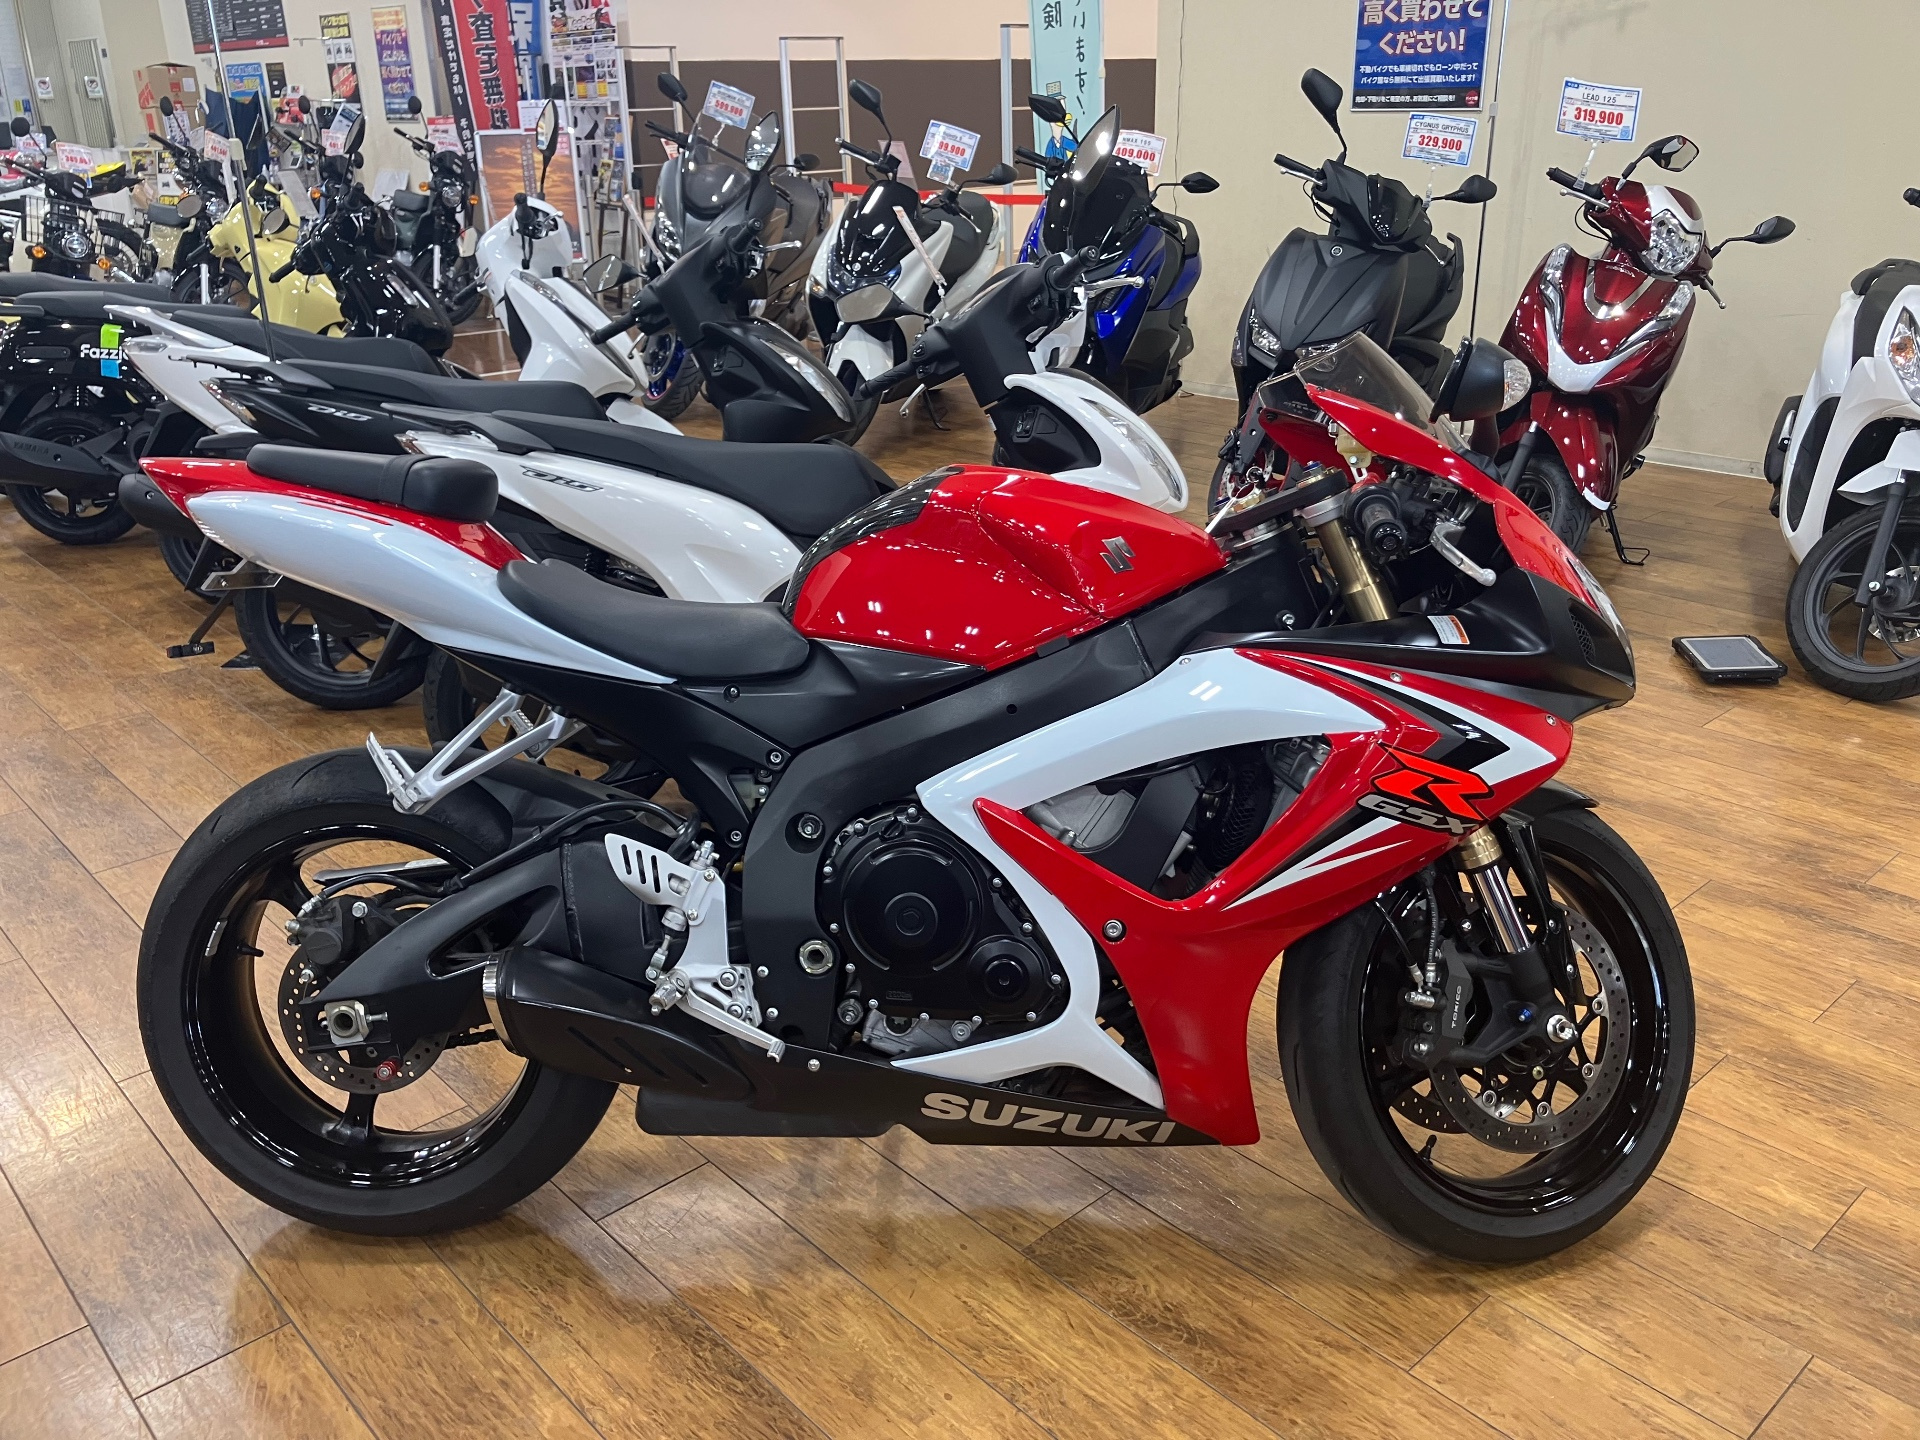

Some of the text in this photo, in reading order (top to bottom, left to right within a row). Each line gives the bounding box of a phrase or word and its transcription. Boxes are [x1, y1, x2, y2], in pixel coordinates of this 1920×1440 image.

[1363, 0, 1483, 25] 高く買わせて
[1379, 28, 1466, 55] ください!
[1582, 92, 1600, 102] LEAD
[1603, 95, 1617, 104] 125
[1574, 106, 1624, 126] 319,900
[1414, 121, 1469, 133] CYGNUS GRYPHUS
[1418, 134, 1463, 152] 329,900
[1115, 146, 1156, 162] 409,000
[13, 441, 49, 455] YAMAHA
[1451, 985, 1462, 1029] TOKICO
[920, 1092, 1176, 1143] SUZUKI
